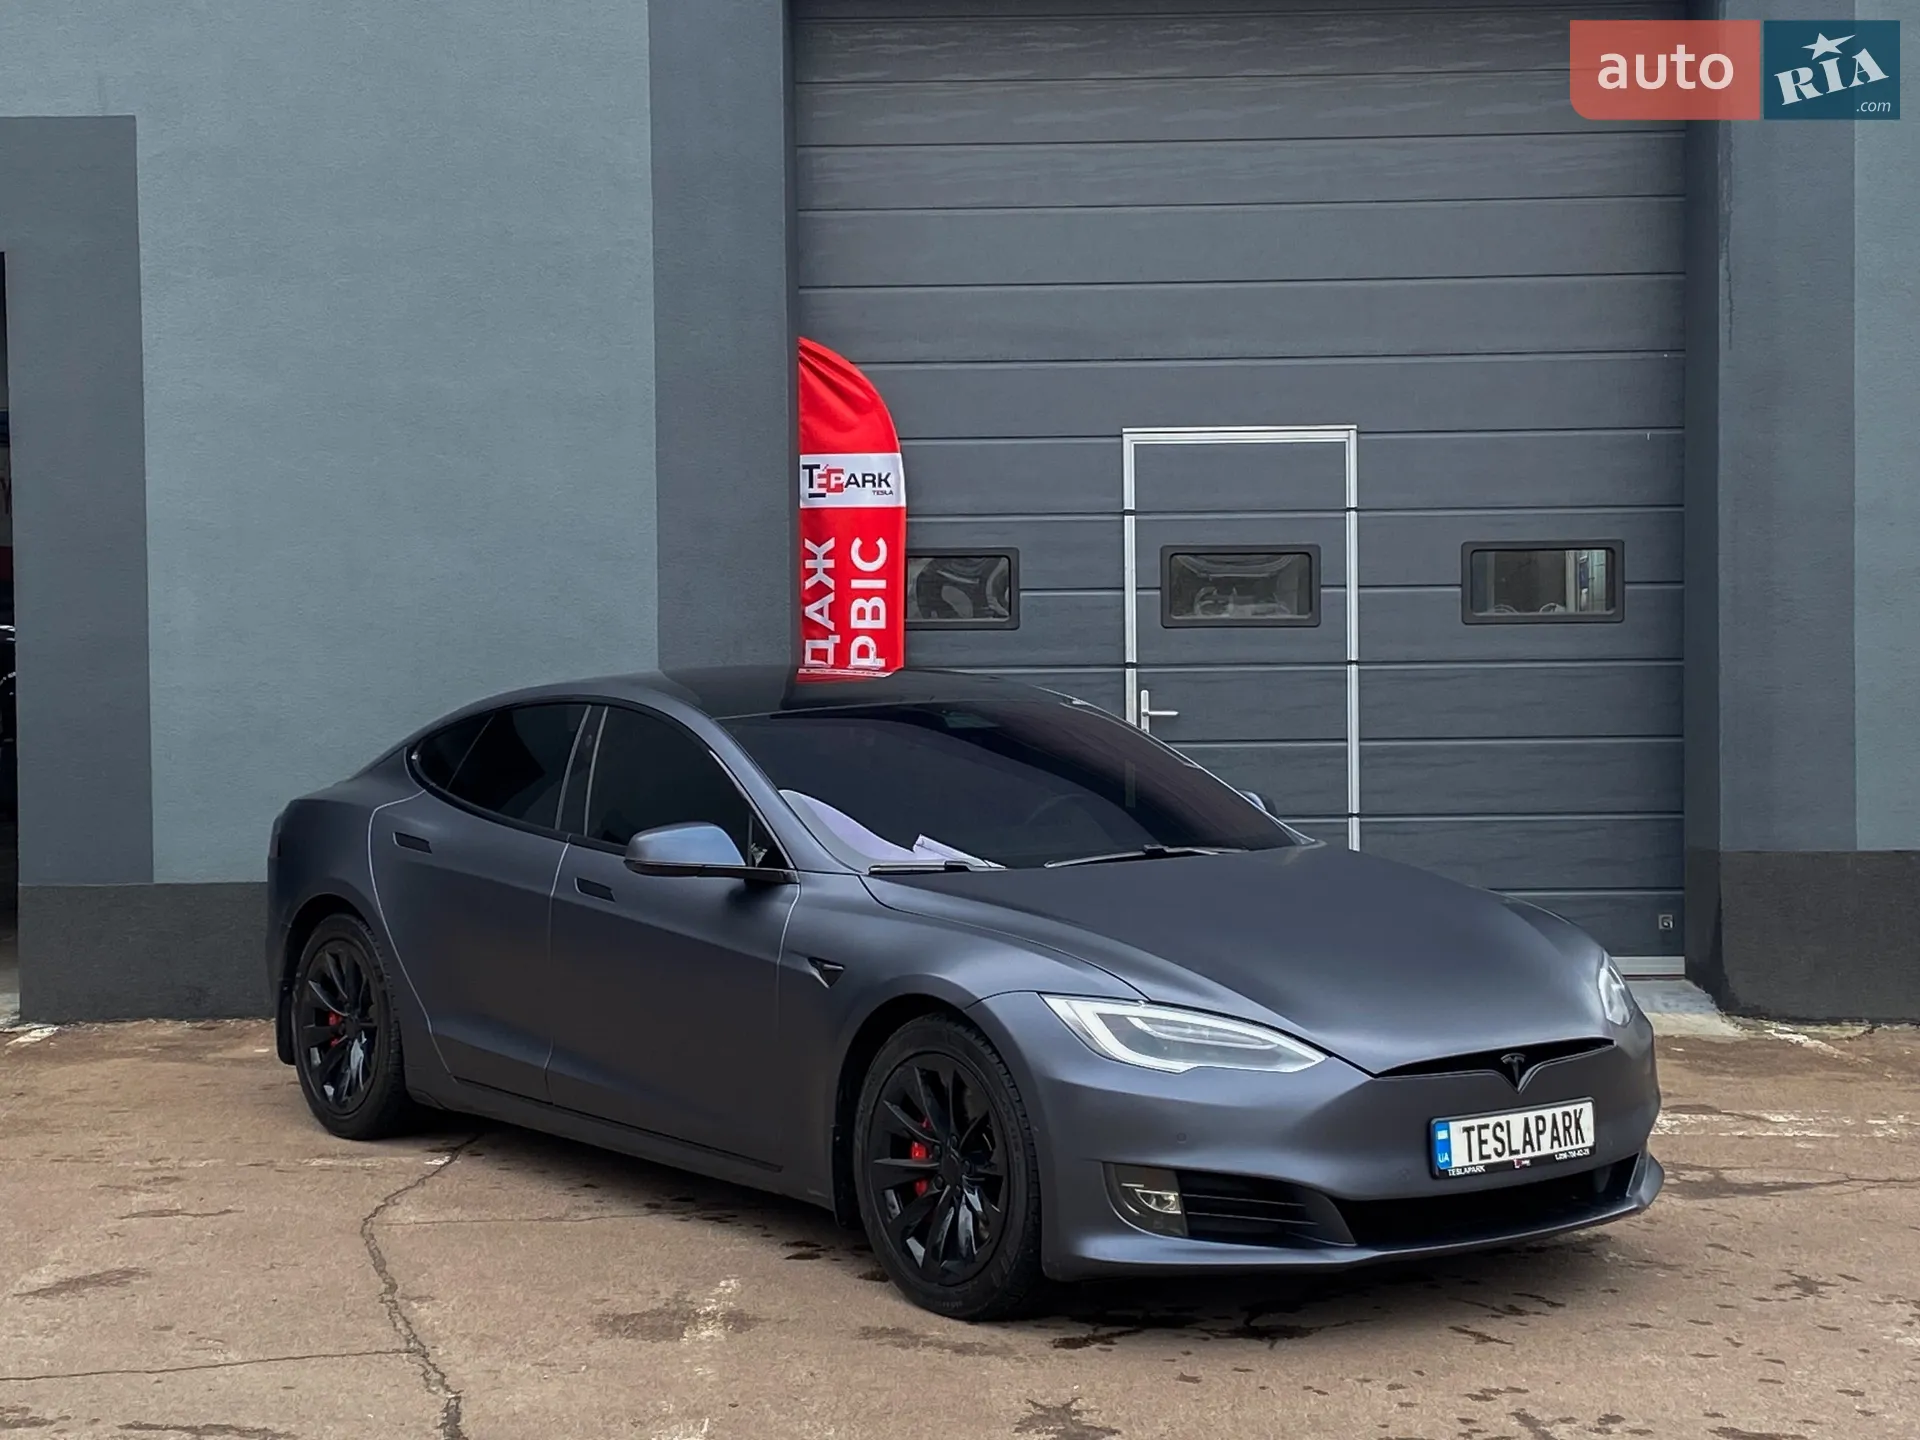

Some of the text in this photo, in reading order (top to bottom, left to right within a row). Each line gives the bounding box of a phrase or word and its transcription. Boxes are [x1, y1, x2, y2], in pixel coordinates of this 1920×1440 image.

[1462, 1108, 1585, 1162] TESLAPARK
[1438, 1153, 1450, 1163] UA
[1448, 1165, 1486, 1176] TESLAPARK
